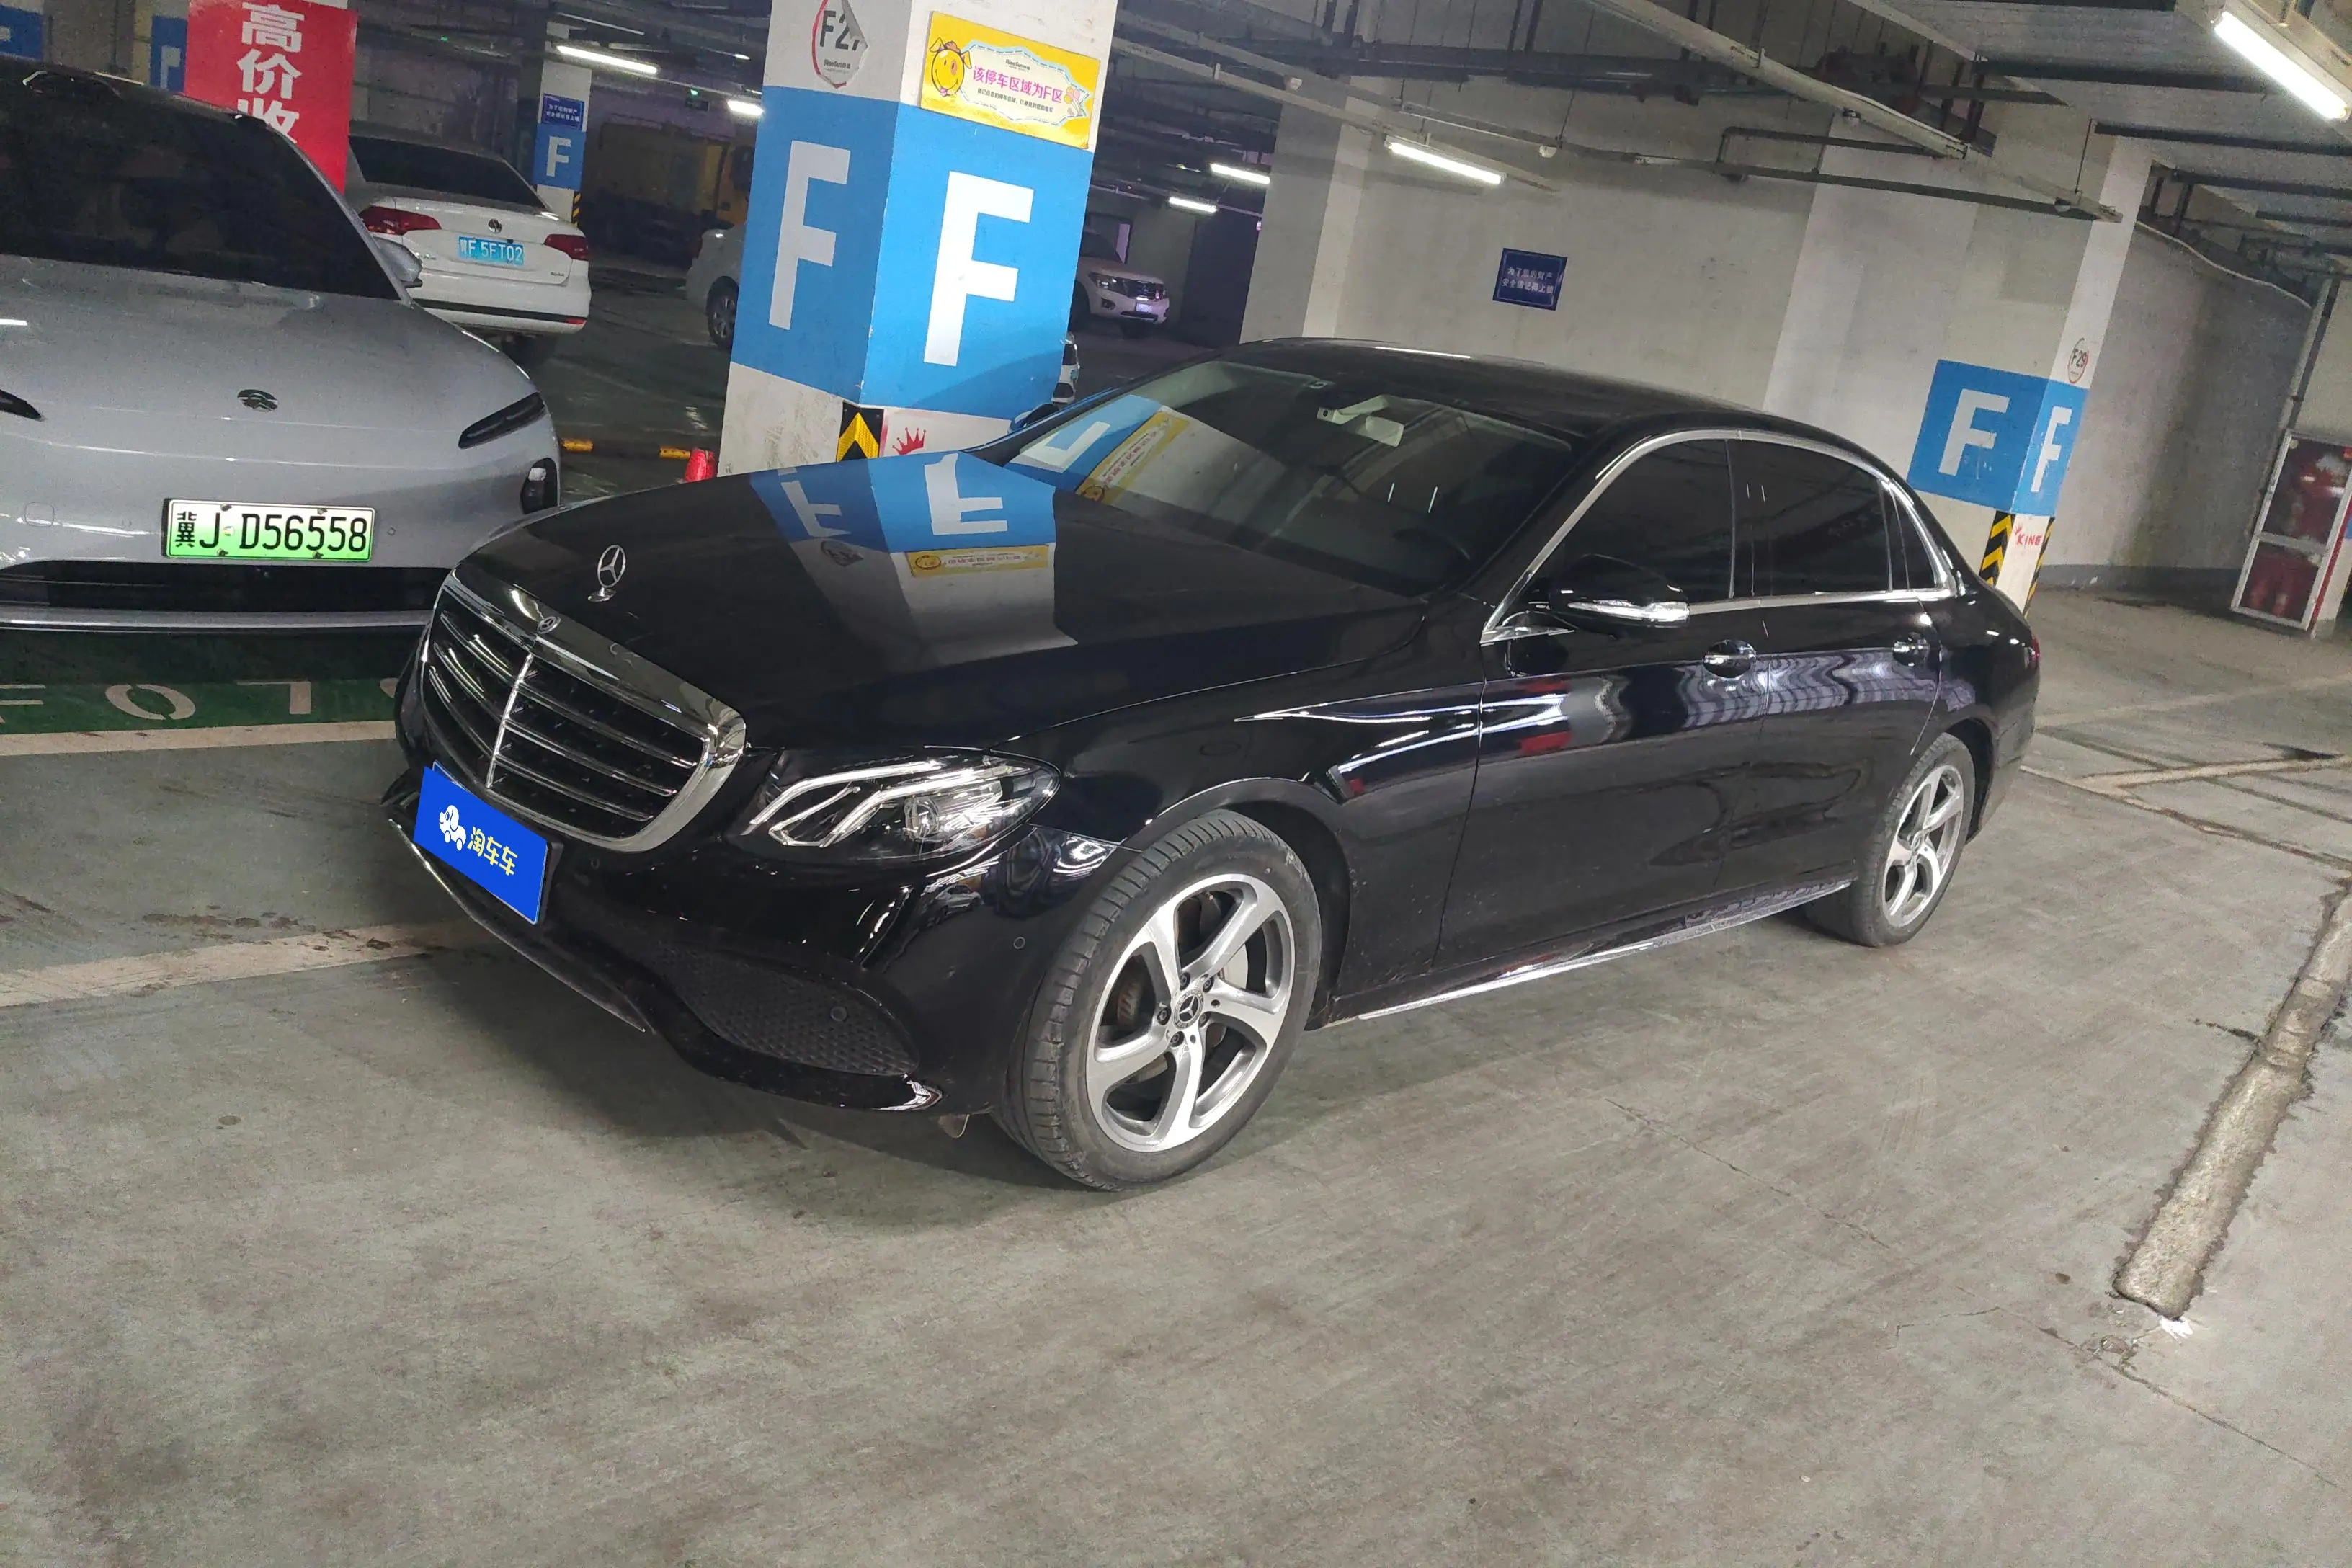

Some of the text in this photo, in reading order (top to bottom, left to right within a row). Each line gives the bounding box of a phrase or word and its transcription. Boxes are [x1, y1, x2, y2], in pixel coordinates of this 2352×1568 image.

[973, 66, 1064, 103] 该停车区域为F区
[546, 135, 571, 177] F
[768, 140, 851, 331] F
[923, 171, 1035, 367] F
[2071, 348, 2088, 368] F29
[1938, 388, 2010, 476] F
[2031, 406, 2072, 493] F
[2017, 533, 2043, 546] KING
